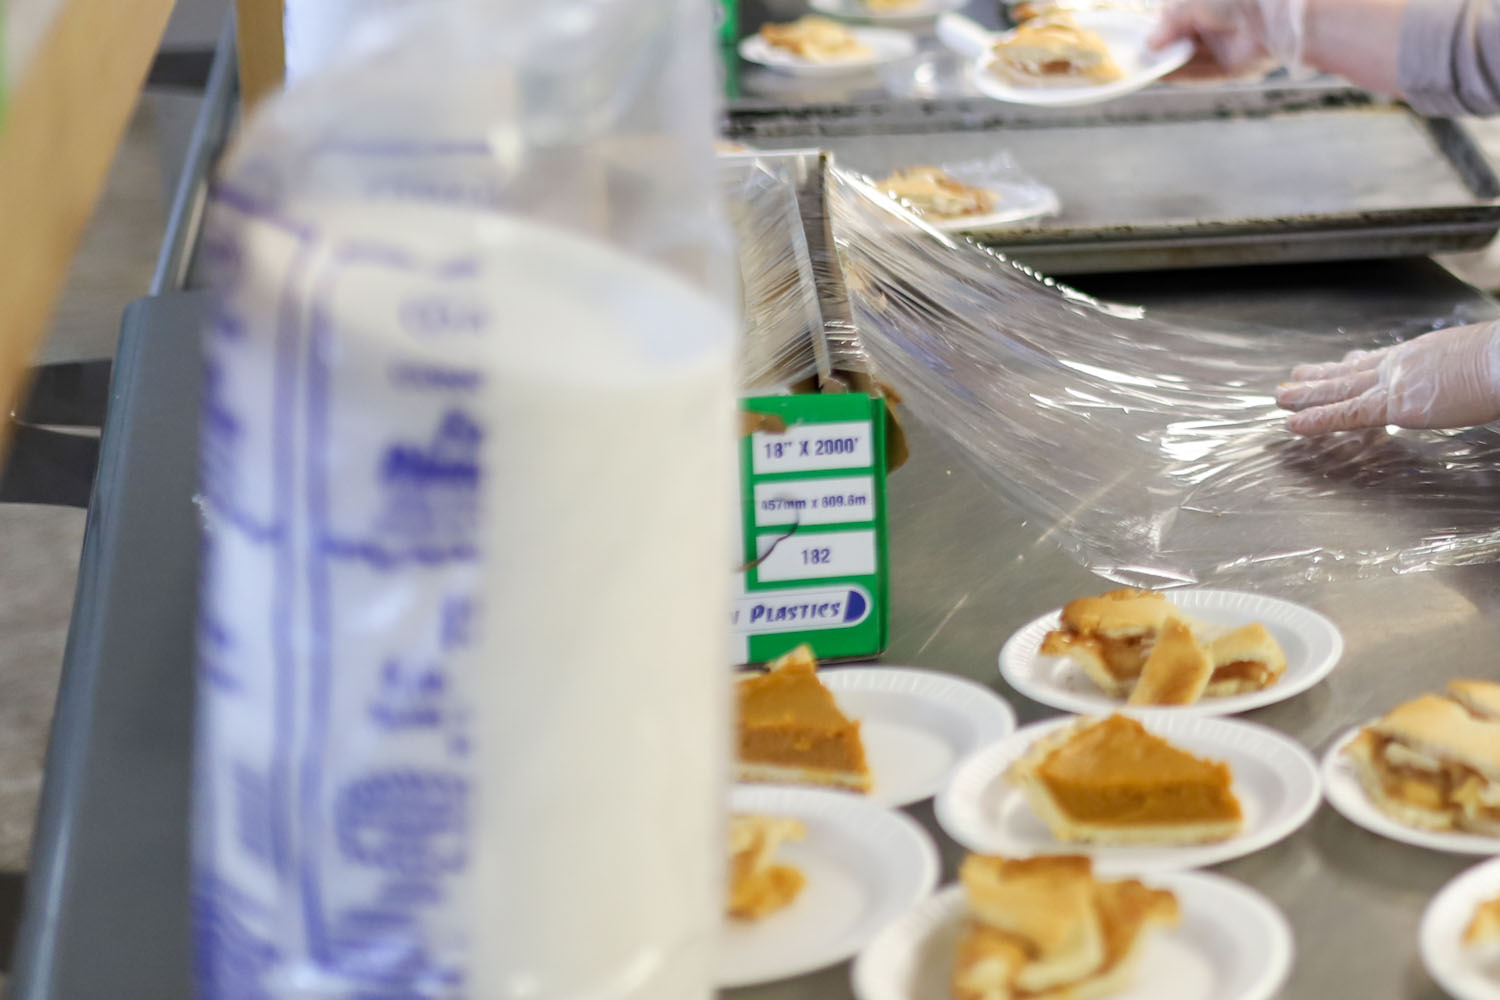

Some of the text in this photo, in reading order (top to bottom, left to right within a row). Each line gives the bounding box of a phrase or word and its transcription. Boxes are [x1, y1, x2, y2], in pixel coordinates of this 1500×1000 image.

[815, 437, 859, 456] 2000'
[801, 547, 831, 565] 182
[749, 602, 841, 624] PLASTICS
